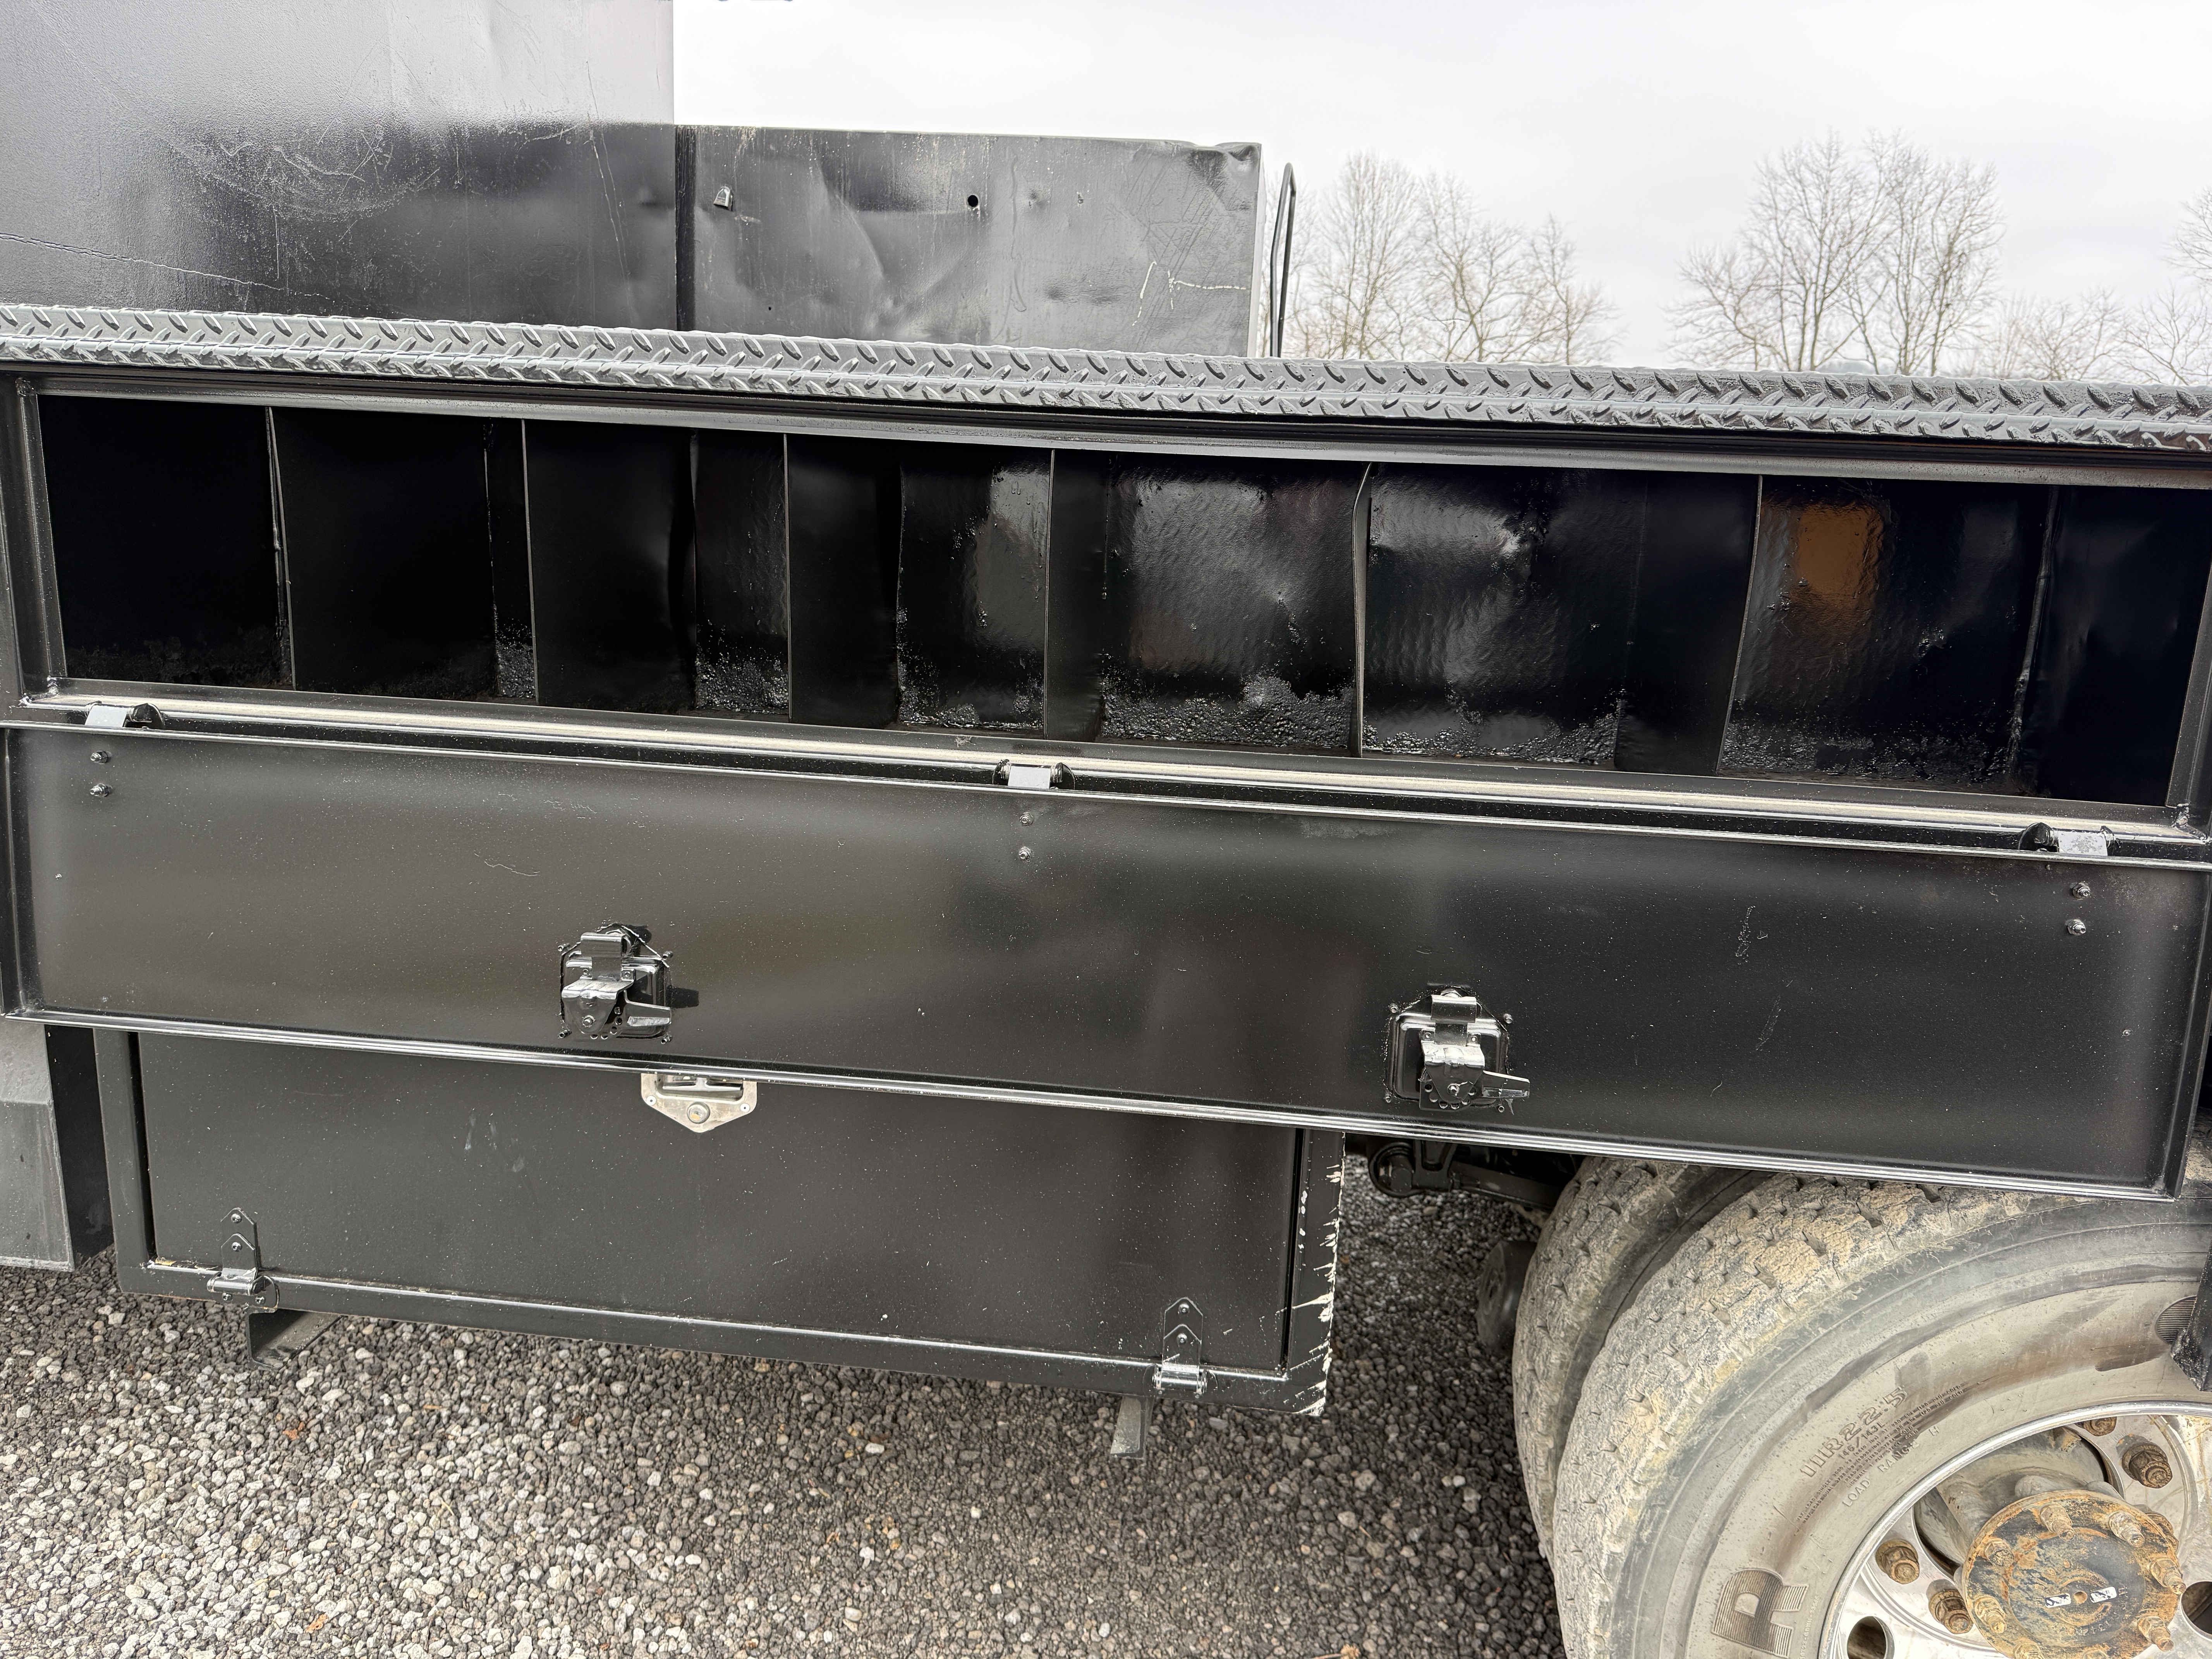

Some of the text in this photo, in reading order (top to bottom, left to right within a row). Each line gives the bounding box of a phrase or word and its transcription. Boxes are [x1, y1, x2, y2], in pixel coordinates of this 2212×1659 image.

[1800, 1385, 1908, 1478] 11R22.5
[1837, 1419, 1885, 1461] 146/143L
[1841, 1424, 1941, 1508] LOAD RANGE H
